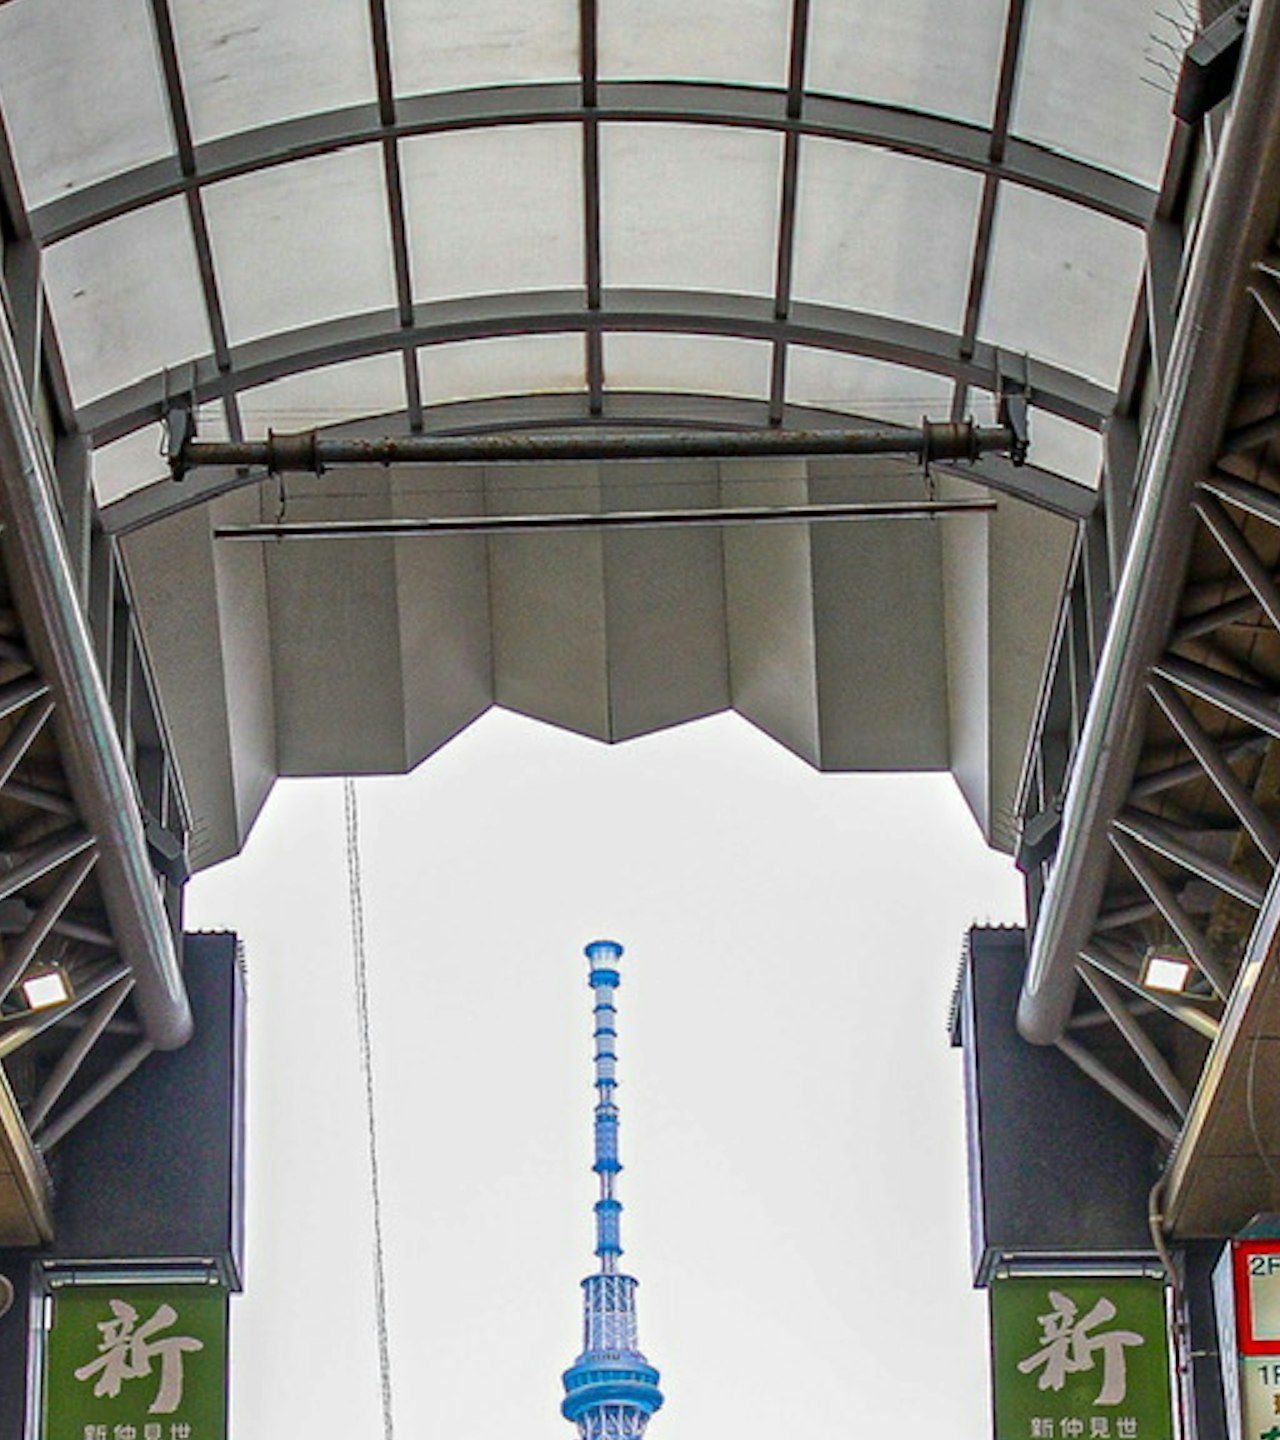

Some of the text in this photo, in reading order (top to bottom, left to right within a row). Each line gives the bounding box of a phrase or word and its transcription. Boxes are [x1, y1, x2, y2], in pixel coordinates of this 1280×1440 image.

[74, 1298, 204, 1414] 新
[1017, 1289, 1145, 1407] 新
[1030, 1416, 1139, 1440] 新仲見世
